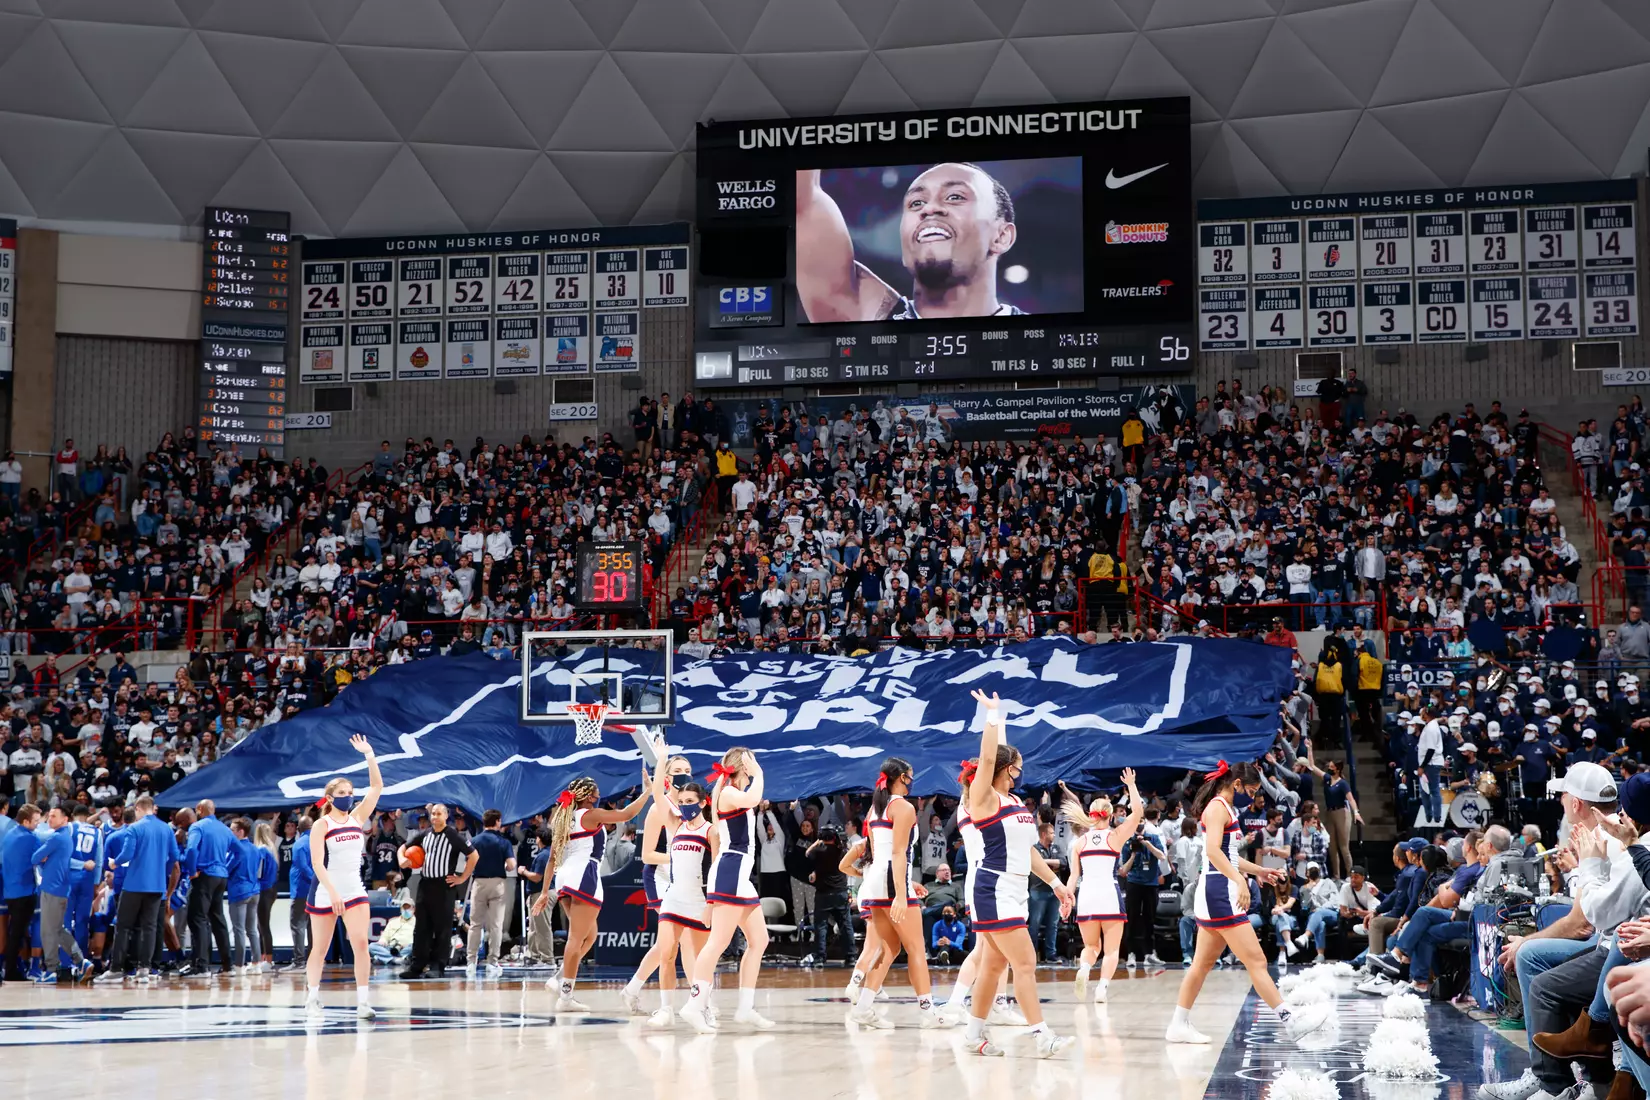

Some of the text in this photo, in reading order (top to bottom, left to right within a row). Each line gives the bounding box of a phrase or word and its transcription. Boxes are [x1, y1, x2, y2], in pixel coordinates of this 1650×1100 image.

[739, 109, 1142, 149] UNIVERSITY OF CONNECTICUT
[717, 180, 776, 194] WELLS
[718, 196, 775, 210] FARGO
[1291, 190, 1534, 210] UCONN HUSKIES OF HONOR
[1123, 223, 1168, 234] DUNKIN'
[1123, 232, 1167, 242] DONUTS
[386, 233, 600, 250] UCONN HUSKIES OF HONOR
[1484, 236, 1505, 260] 23
[1539, 234, 1562, 259] 31
[1596, 231, 1620, 256] 14
[1272, 247, 1281, 270] 3
[1376, 242, 1396, 265] 20
[1431, 239, 1449, 263] 31
[1214, 249, 1233, 272] 32
[455, 281, 483, 303] 52
[502, 279, 534, 301] 42
[556, 277, 579, 299] 25
[608, 275, 625, 297] 33
[659, 273, 674, 295] 10
[1102, 286, 1161, 298] TRAVELERS
[308, 287, 339, 309] 24
[356, 285, 387, 307] 50
[408, 283, 433, 305] 21
[720, 287, 767, 303] CBS
[1380, 308, 1394, 332] 3
[1426, 306, 1456, 331] CD
[1485, 304, 1508, 328] 15
[1534, 302, 1572, 326] 24
[1593, 300, 1630, 324] 33
[1208, 314, 1238, 339] 23
[1270, 313, 1285, 336] 4
[1317, 310, 1347, 335] 30
[836, 337, 856, 346] POSS
[871, 335, 897, 344] BONUS
[982, 330, 1008, 340] BONUS
[1024, 329, 1044, 338] POSS
[926, 335, 967, 356] 3:55
[1160, 336, 1189, 360] 56
[991, 361, 1006, 371] TM
[1009, 360, 1025, 370] FLS
[1052, 359, 1064, 369] 30
[1067, 358, 1086, 368] SEC
[1111, 356, 1132, 367] FULL
[750, 368, 772, 380] FULL
[796, 366, 828, 379] 30 SEC
[845, 364, 888, 377] 5 TM FLS
[954, 394, 1134, 409] Harry A. Gampel Pavilion Storrs, CT
[570, 406, 596, 416] 202
[966, 408, 1120, 421] Basketball Capital of the World
[307, 415, 330, 425] 201
[866, 524, 871, 532] 2
[599, 552, 632, 569] 3:55
[593, 572, 627, 602] 30
[1413, 671, 1444, 684] 105
[1017, 815, 1034, 824] UCO
[336, 834, 360, 842] UCONN
[1059, 827, 1064, 837] 2
[76, 833, 94, 853] 10
[673, 844, 702, 853] UCONN
[378, 851, 392, 863] 34
[932, 847, 942, 858] 34
[598, 932, 657, 947] TRAVEL
